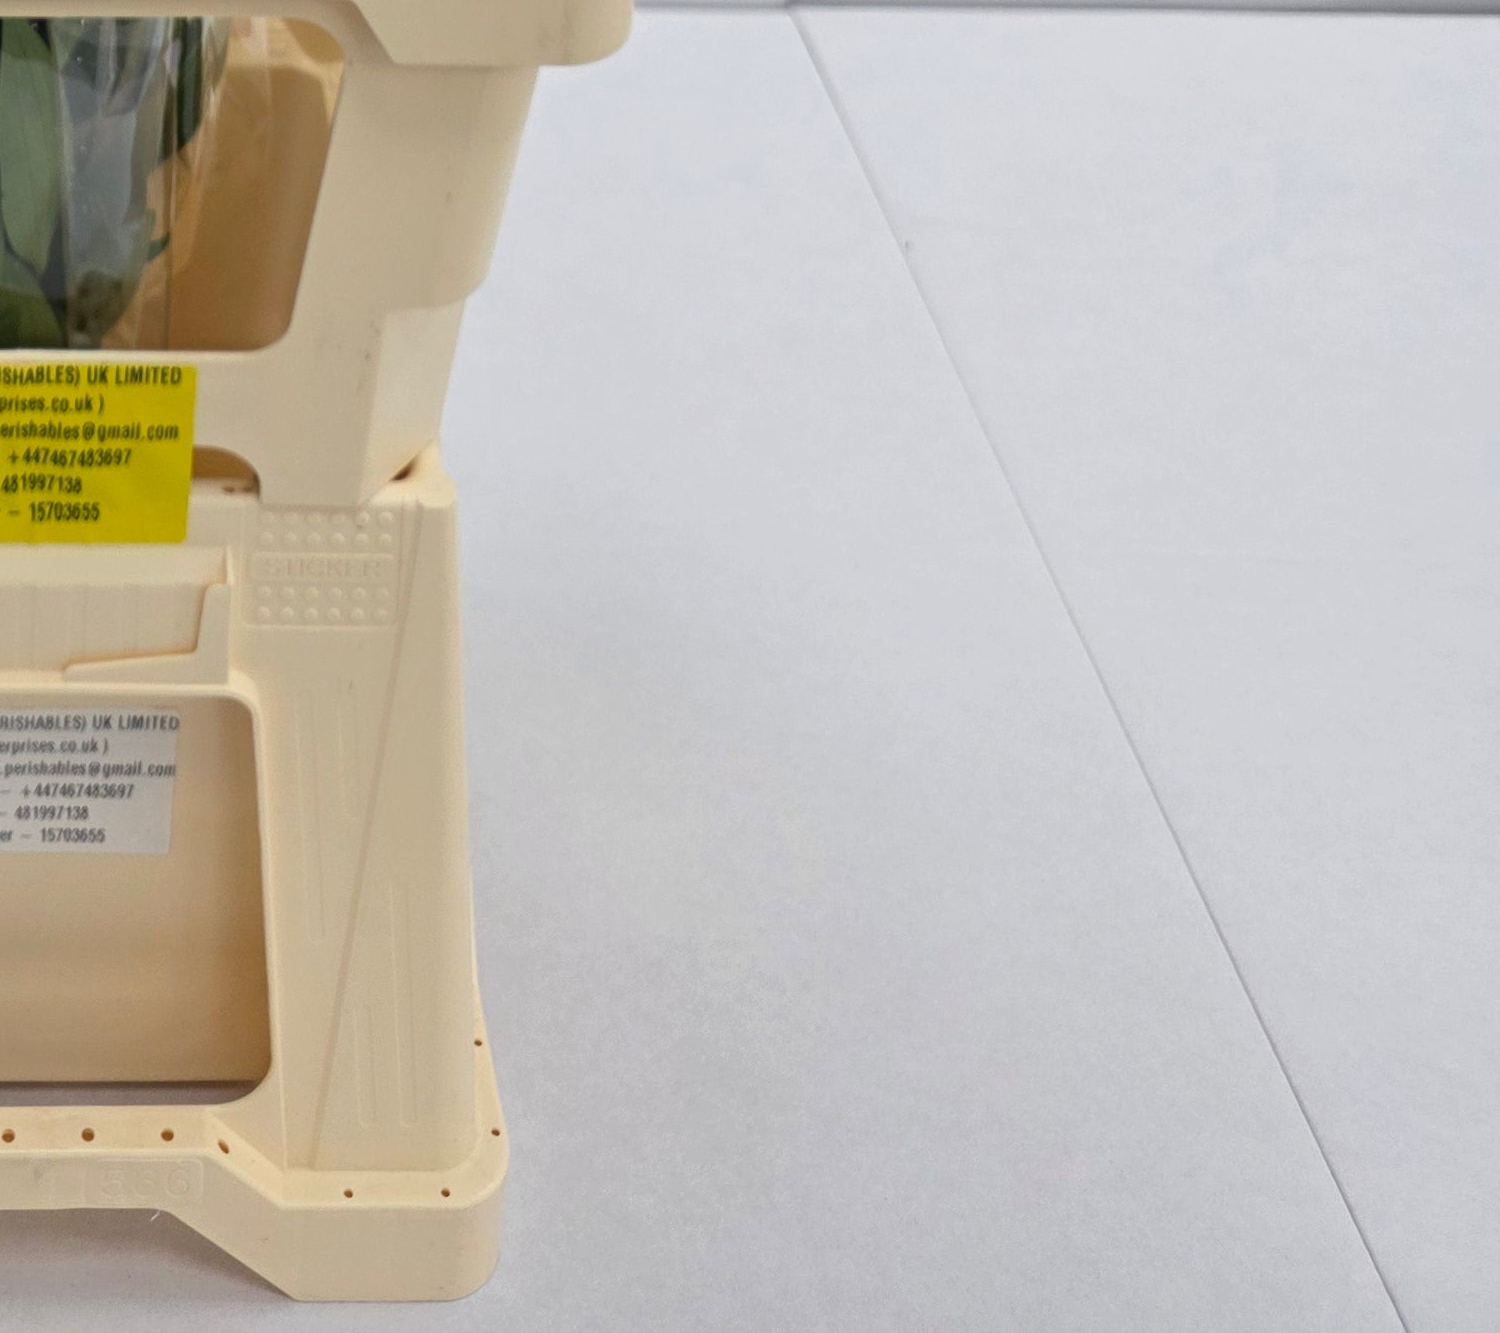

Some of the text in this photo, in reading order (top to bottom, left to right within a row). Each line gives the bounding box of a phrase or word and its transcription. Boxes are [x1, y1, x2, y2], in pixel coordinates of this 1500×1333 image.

[87, 366, 109, 384] UK
[115, 366, 181, 384] LIMITED
[8, 448, 132, 466] +447467483697
[1, 474, 82, 493] 481997138
[29, 503, 100, 522] 15703655
